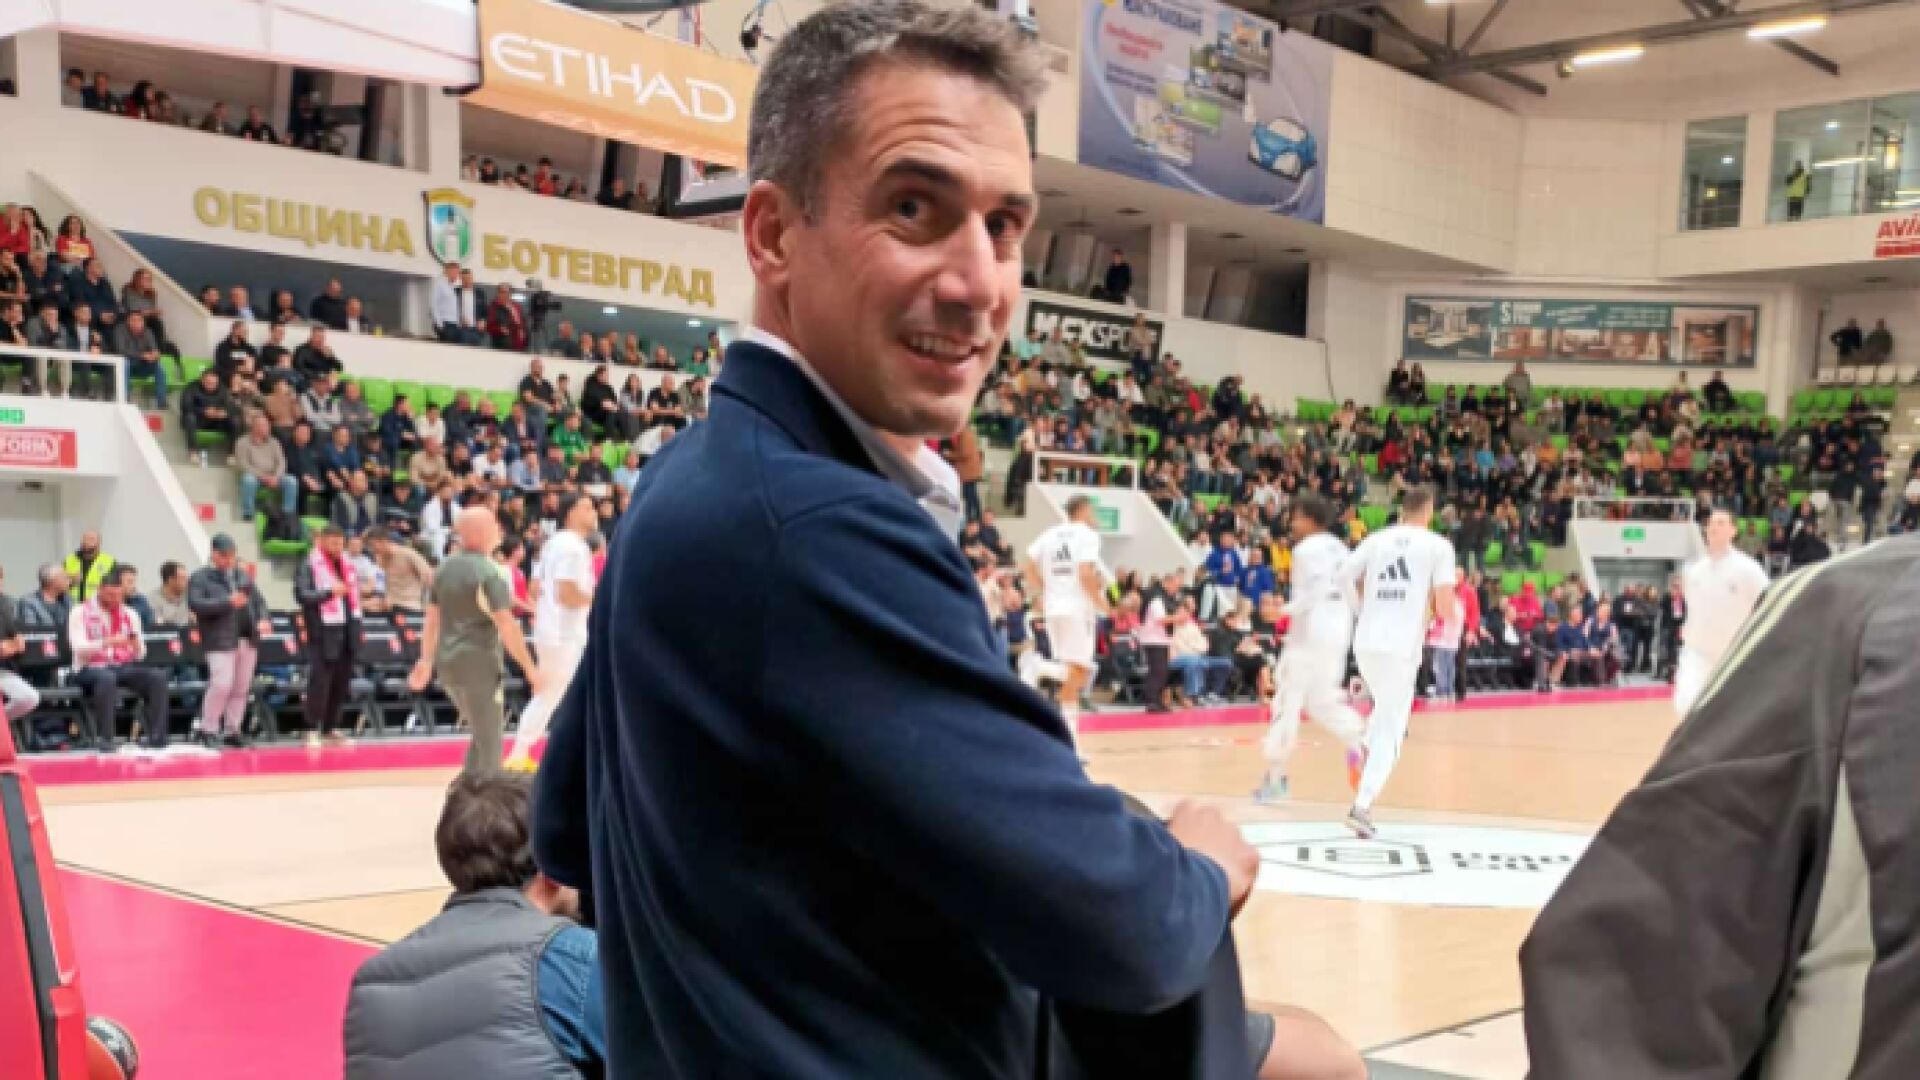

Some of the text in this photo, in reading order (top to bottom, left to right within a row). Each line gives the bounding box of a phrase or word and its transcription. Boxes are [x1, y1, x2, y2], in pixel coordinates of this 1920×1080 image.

[489, 32, 737, 123] ETIHAD
[193, 185, 716, 308] ОБЩИНА БОТЕВГРАД
